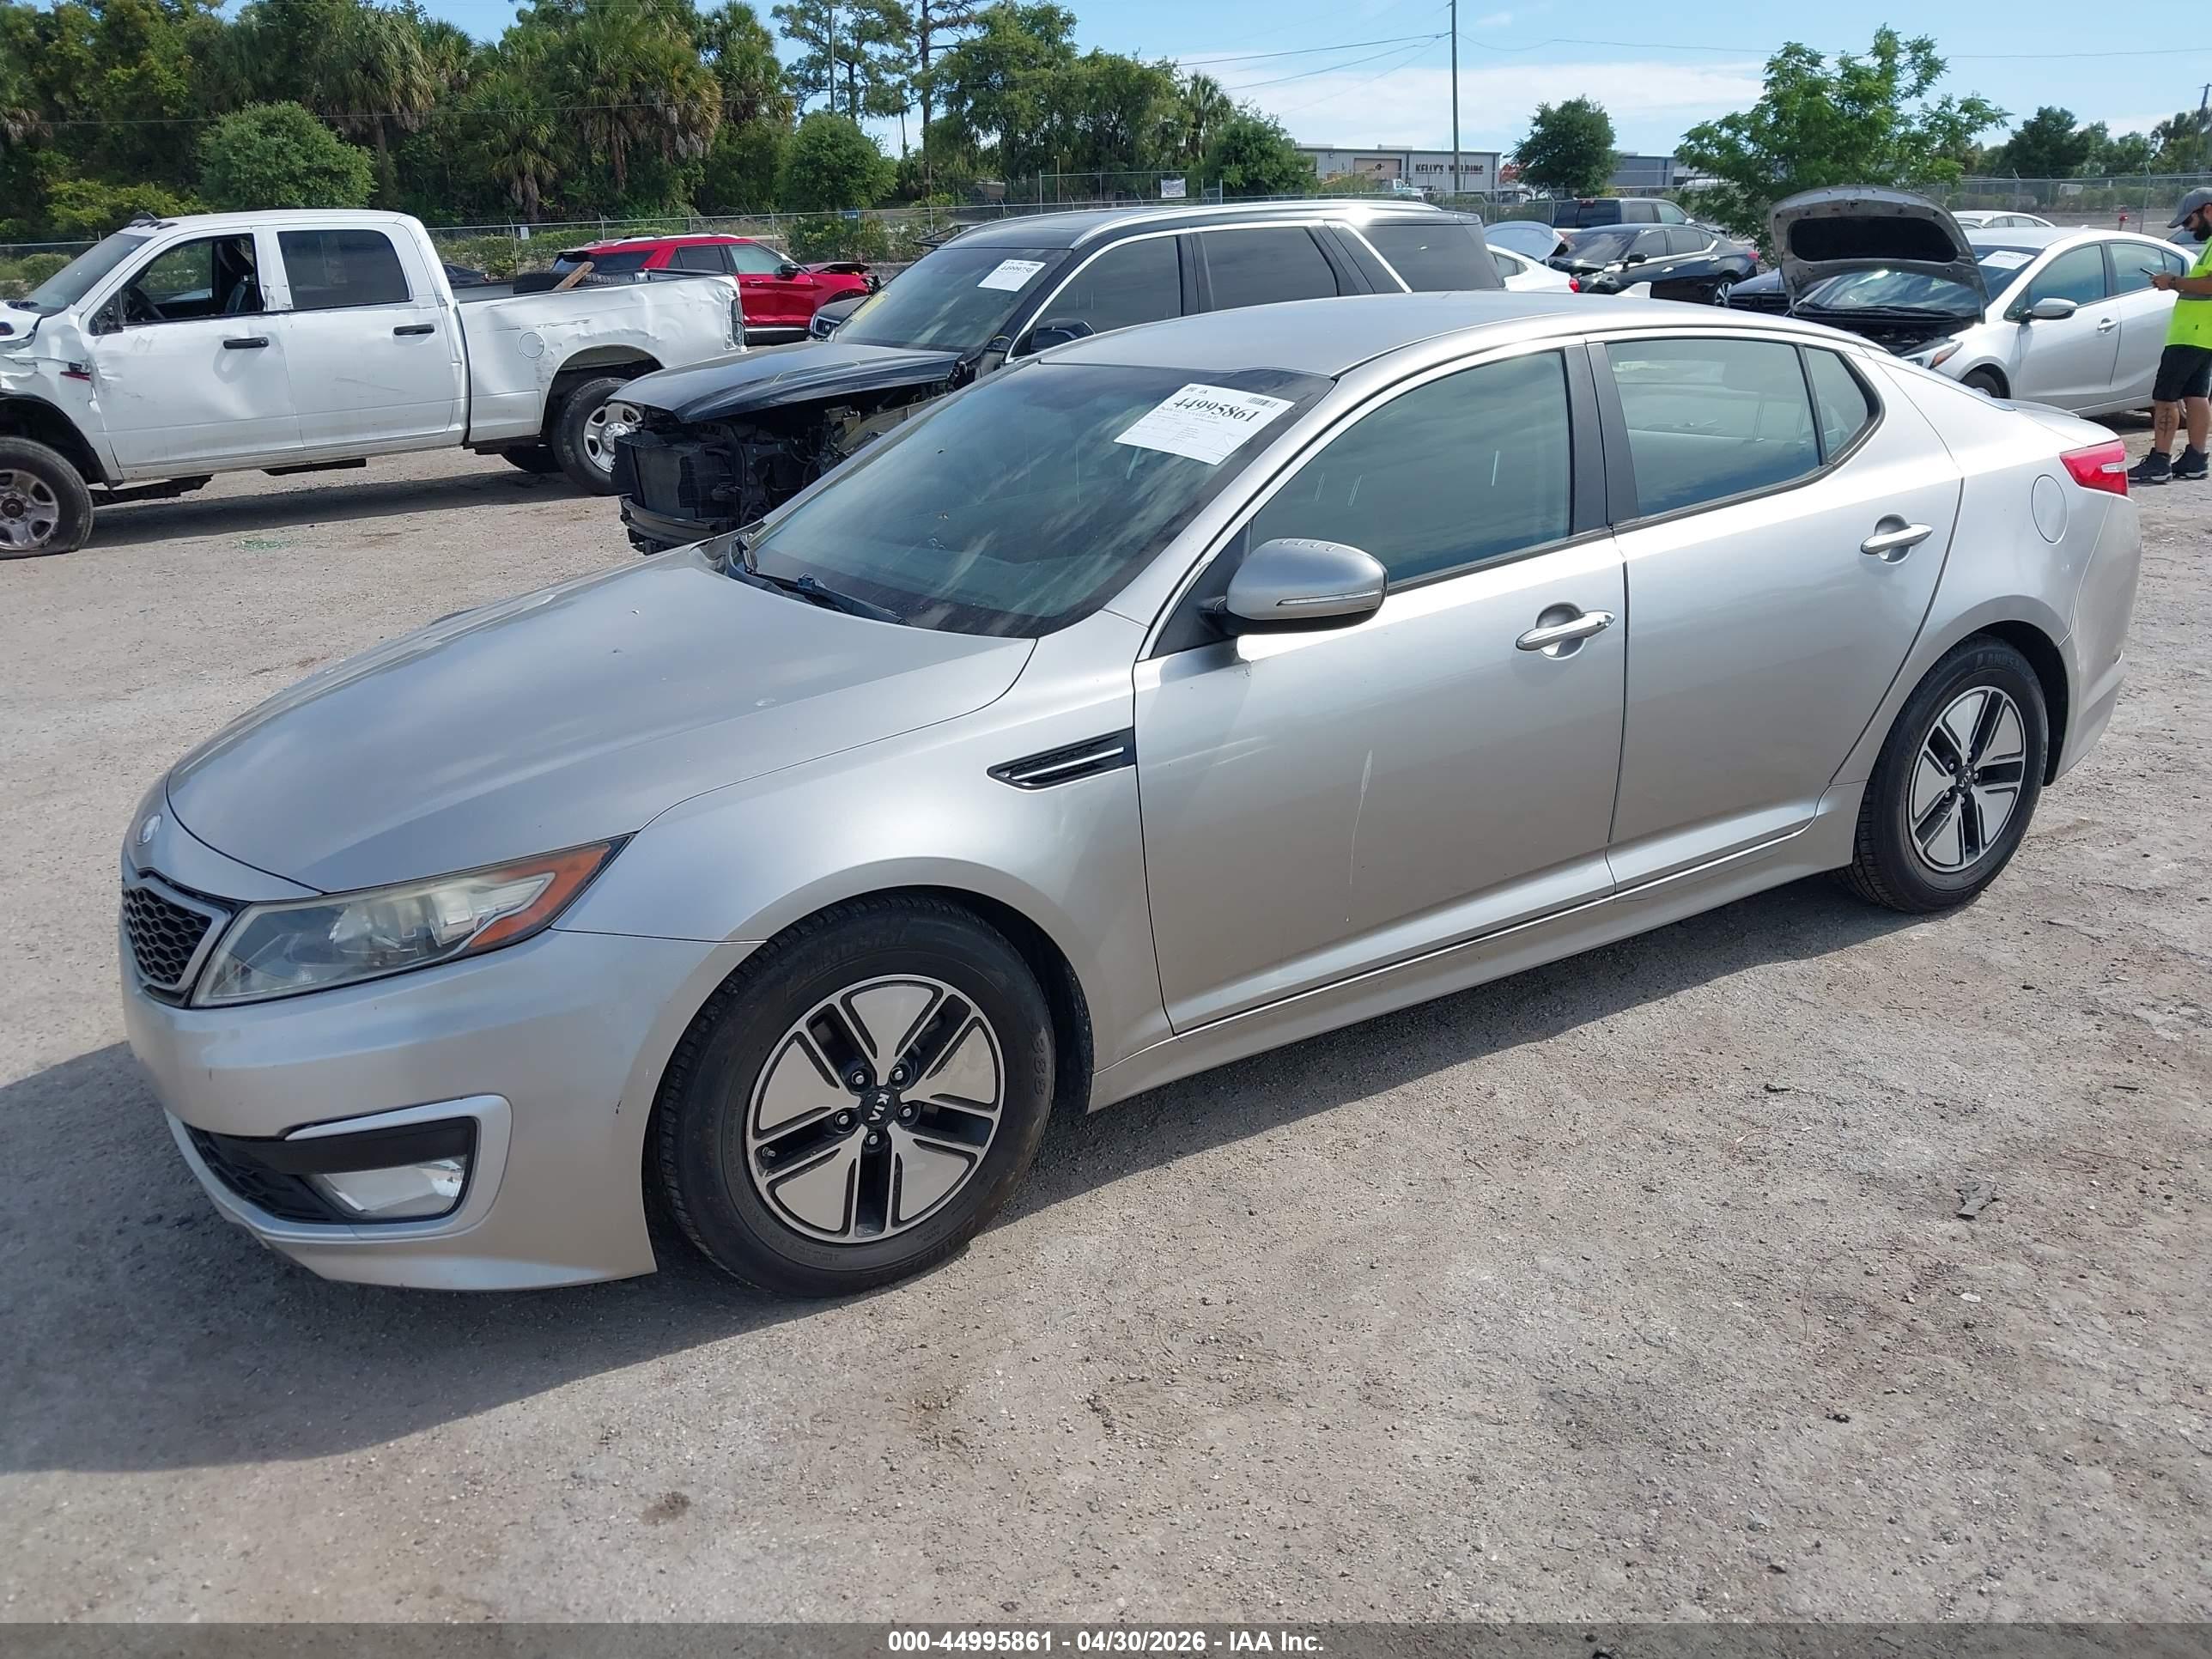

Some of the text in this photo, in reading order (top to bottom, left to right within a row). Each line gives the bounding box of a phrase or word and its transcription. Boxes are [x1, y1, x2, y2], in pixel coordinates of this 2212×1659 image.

[1415, 163, 1484, 173] KELLY'S WLDING
[1173, 396, 1261, 422] 44995861
[868, 1092, 890, 1121] KIA
